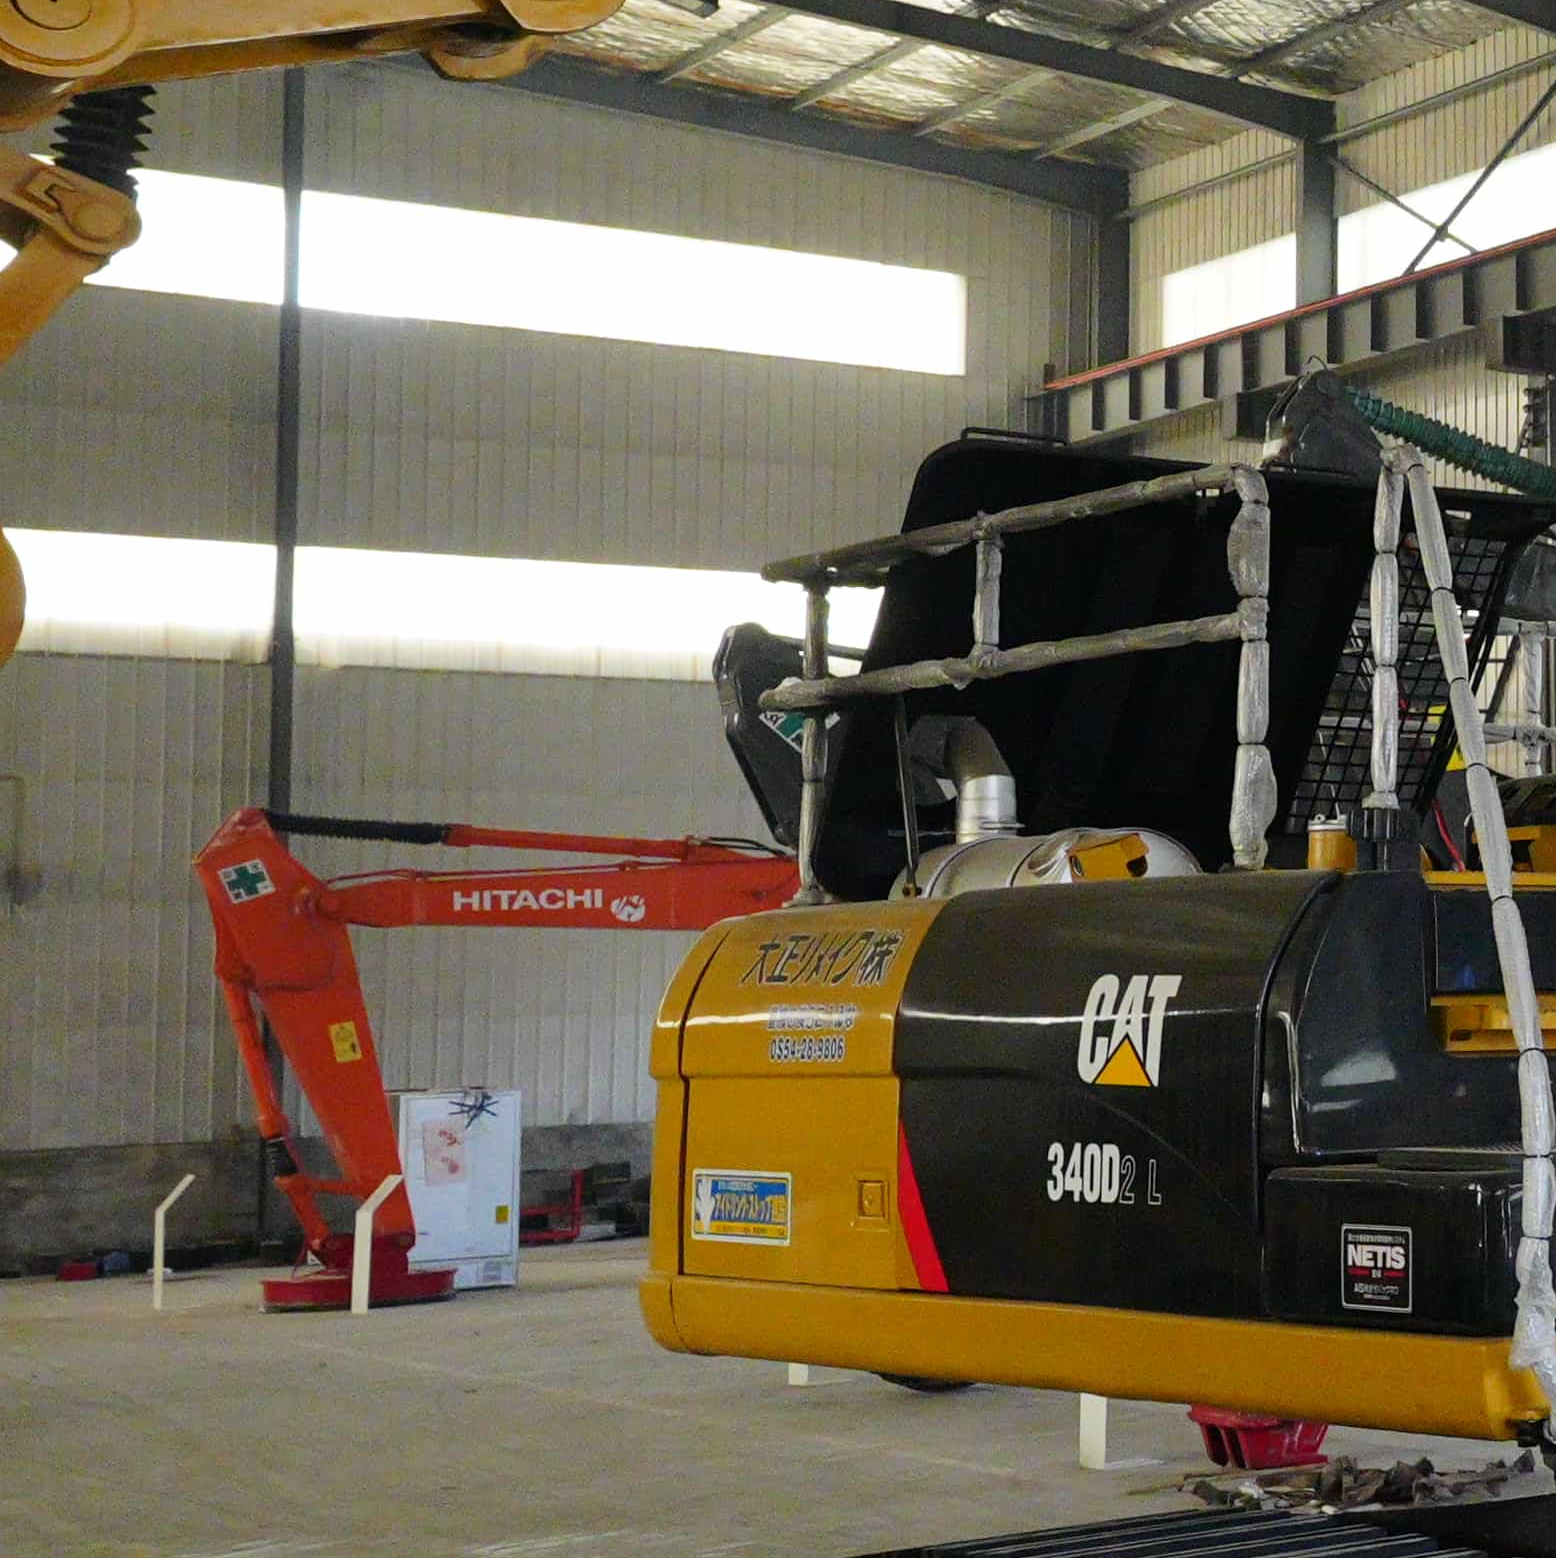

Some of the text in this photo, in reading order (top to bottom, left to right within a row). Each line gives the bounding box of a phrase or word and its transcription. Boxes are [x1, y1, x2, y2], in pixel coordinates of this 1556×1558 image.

[453, 889, 603, 911] HITACHI
[1077, 974, 1182, 1087] CAT
[1347, 1243, 1406, 1270] NETIS
